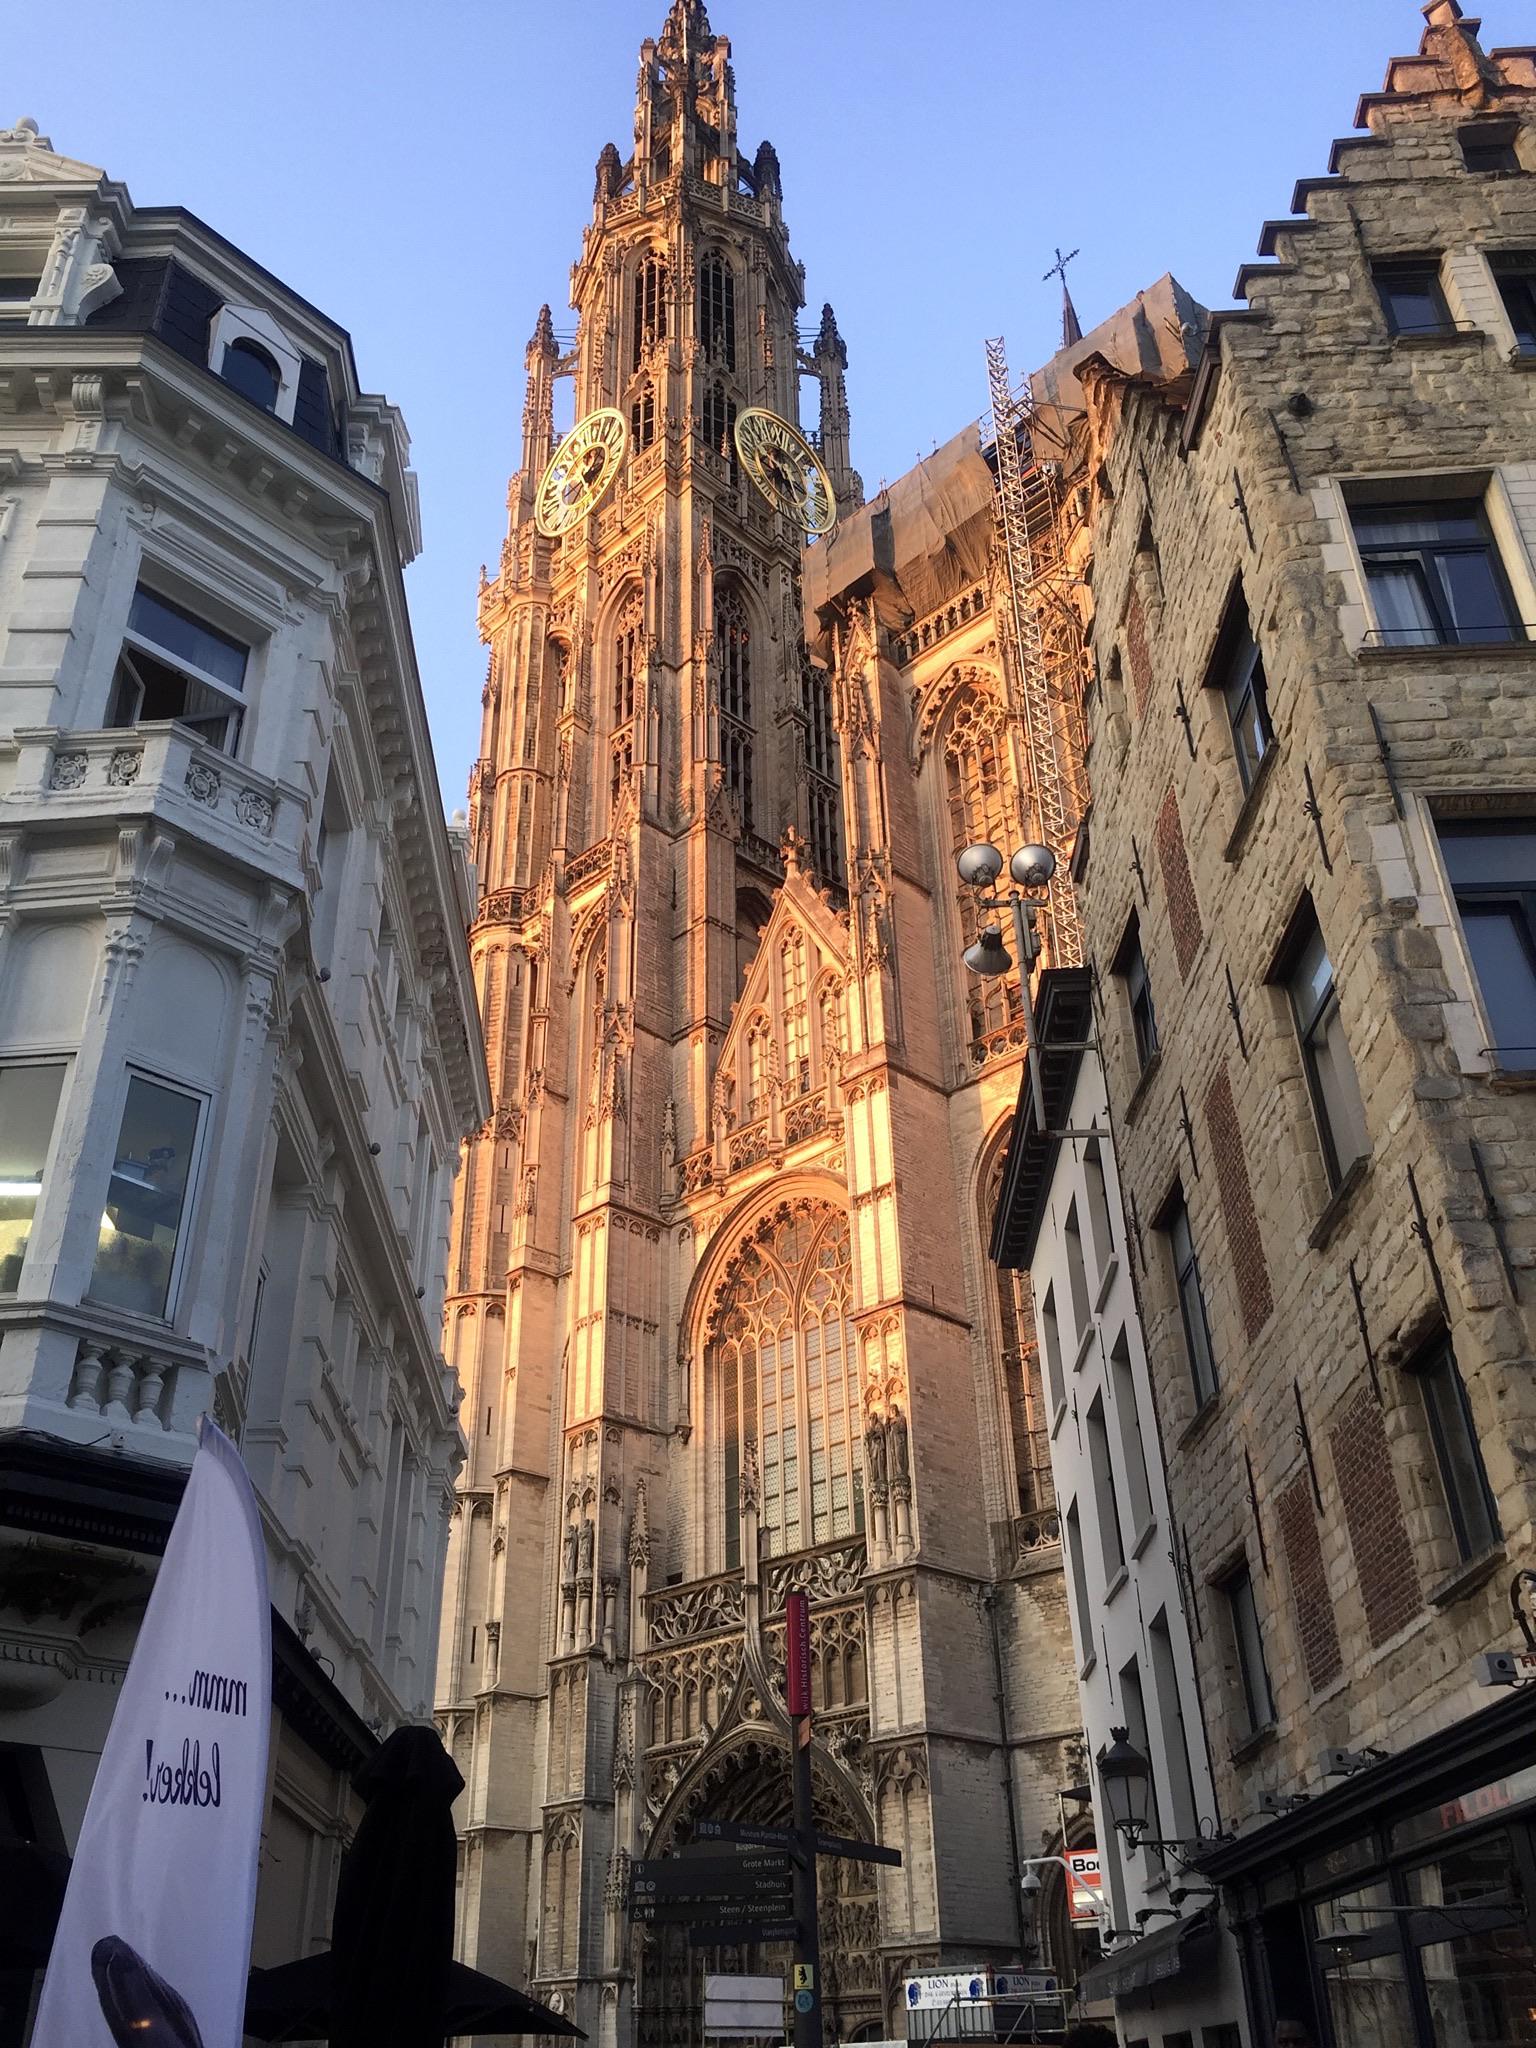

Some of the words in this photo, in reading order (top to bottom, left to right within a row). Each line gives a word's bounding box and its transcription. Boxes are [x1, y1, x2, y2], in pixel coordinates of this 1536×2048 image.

[800, 1641, 808, 1688] Historisch
[742, 1859, 762, 1869] Grote
[763, 1859, 785, 1867] Markt
[755, 1880, 786, 1889] Stadhuis
[720, 1904, 740, 1914] Steen
[748, 1904, 786, 1914] Steenplein
[928, 1979, 949, 1989] LION
[1013, 1977, 1030, 1986] LION
